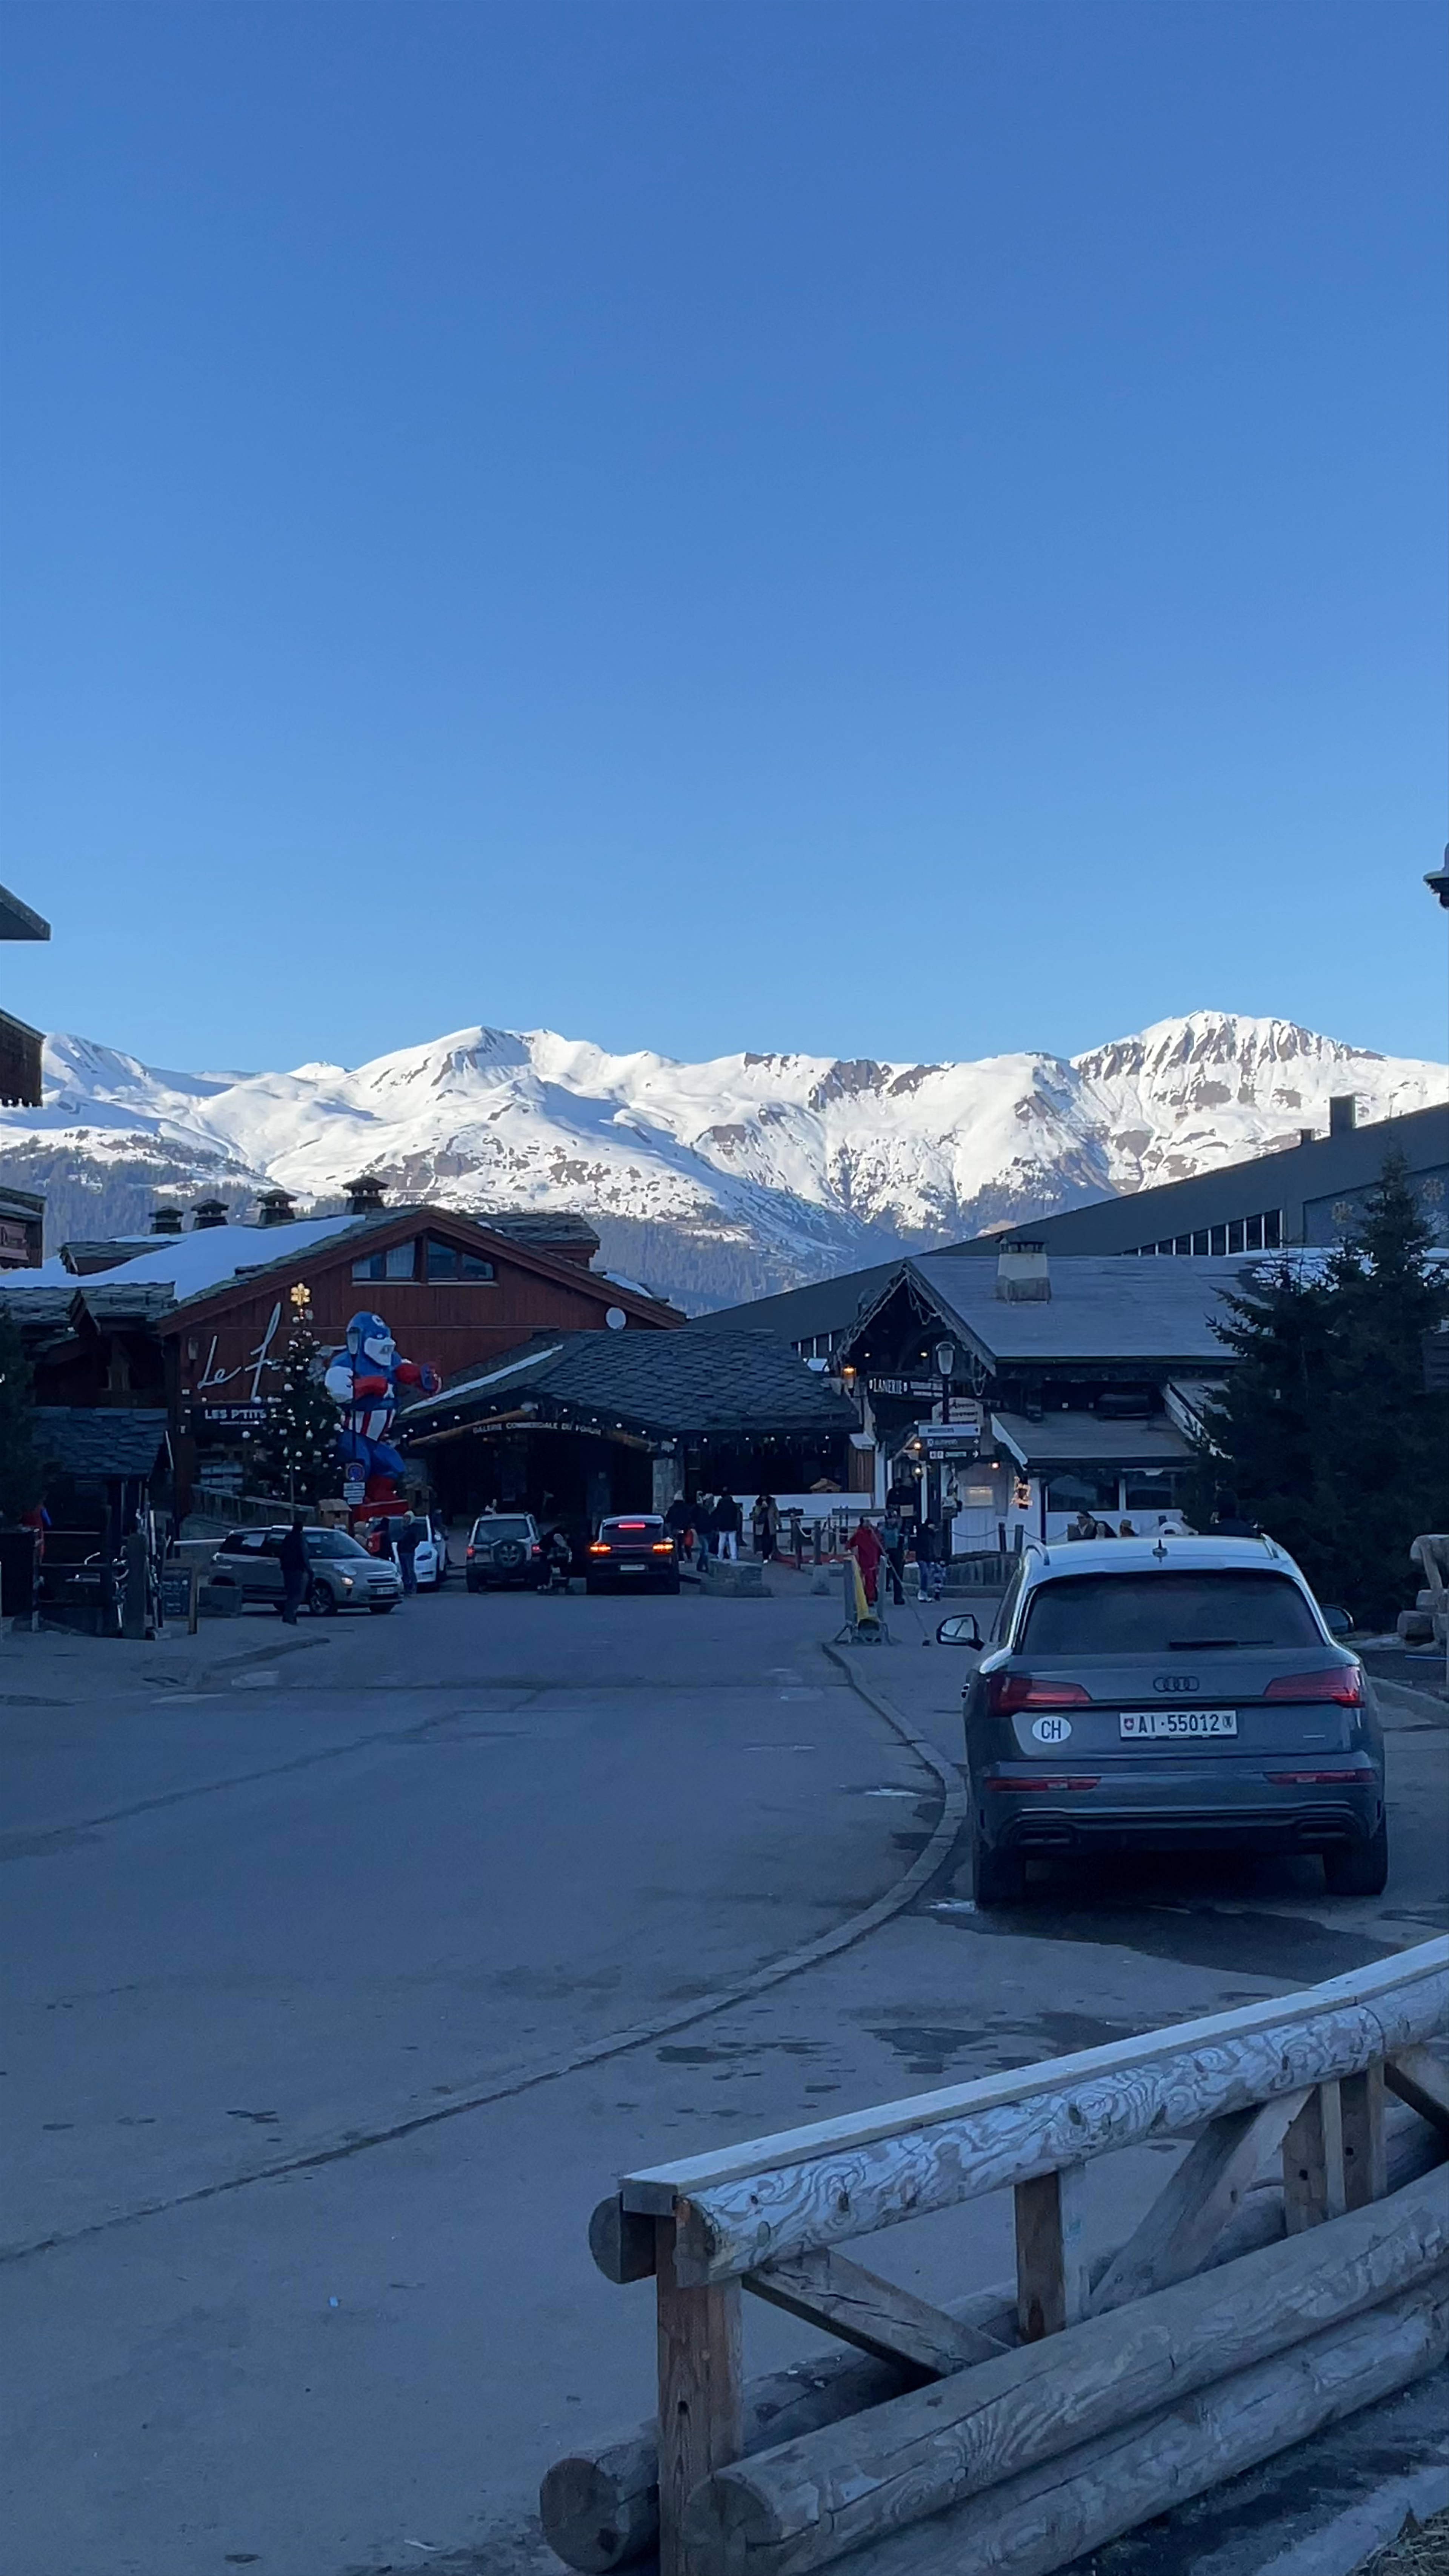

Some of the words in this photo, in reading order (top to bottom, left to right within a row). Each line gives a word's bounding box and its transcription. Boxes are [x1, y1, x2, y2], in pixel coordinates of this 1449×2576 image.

[197, 1336, 242, 1389] Le
[205, 1409, 228, 1419] LES
[1041, 1720, 1061, 1739] CH
